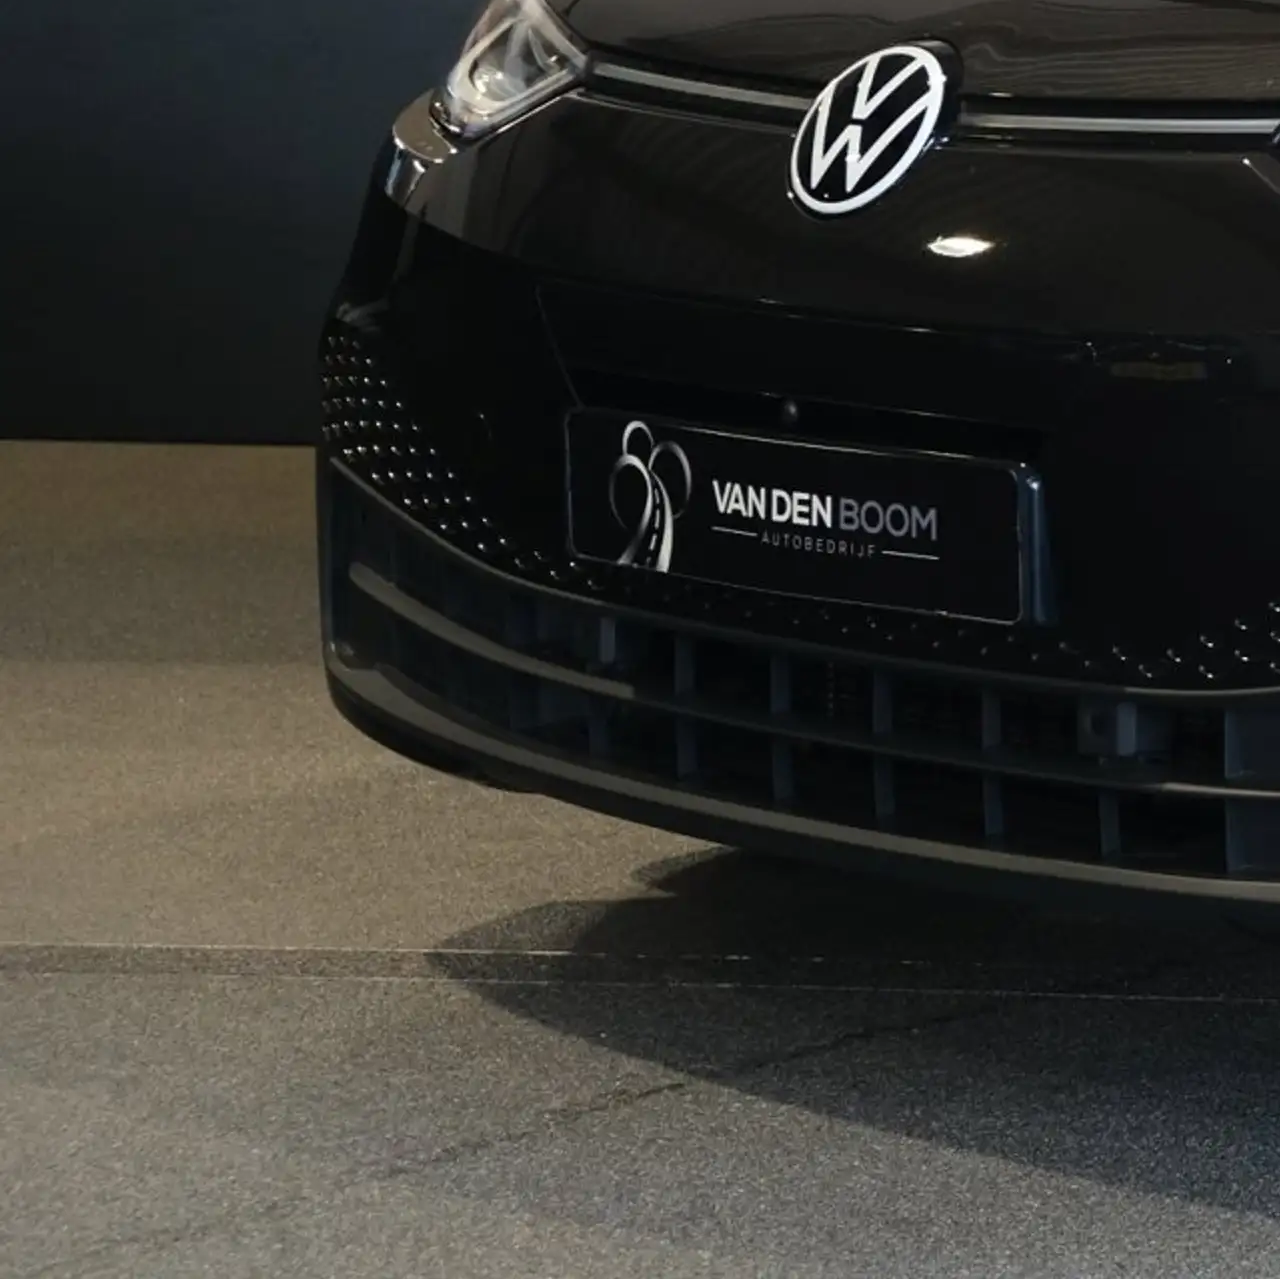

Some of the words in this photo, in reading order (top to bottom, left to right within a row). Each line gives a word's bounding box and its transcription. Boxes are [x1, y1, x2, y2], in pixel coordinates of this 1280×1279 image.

[711, 479, 766, 520] VAN
[771, 488, 832, 528] DEN
[839, 497, 938, 541] BOOM
[761, 529, 877, 559] AUTOBEDRIJF
